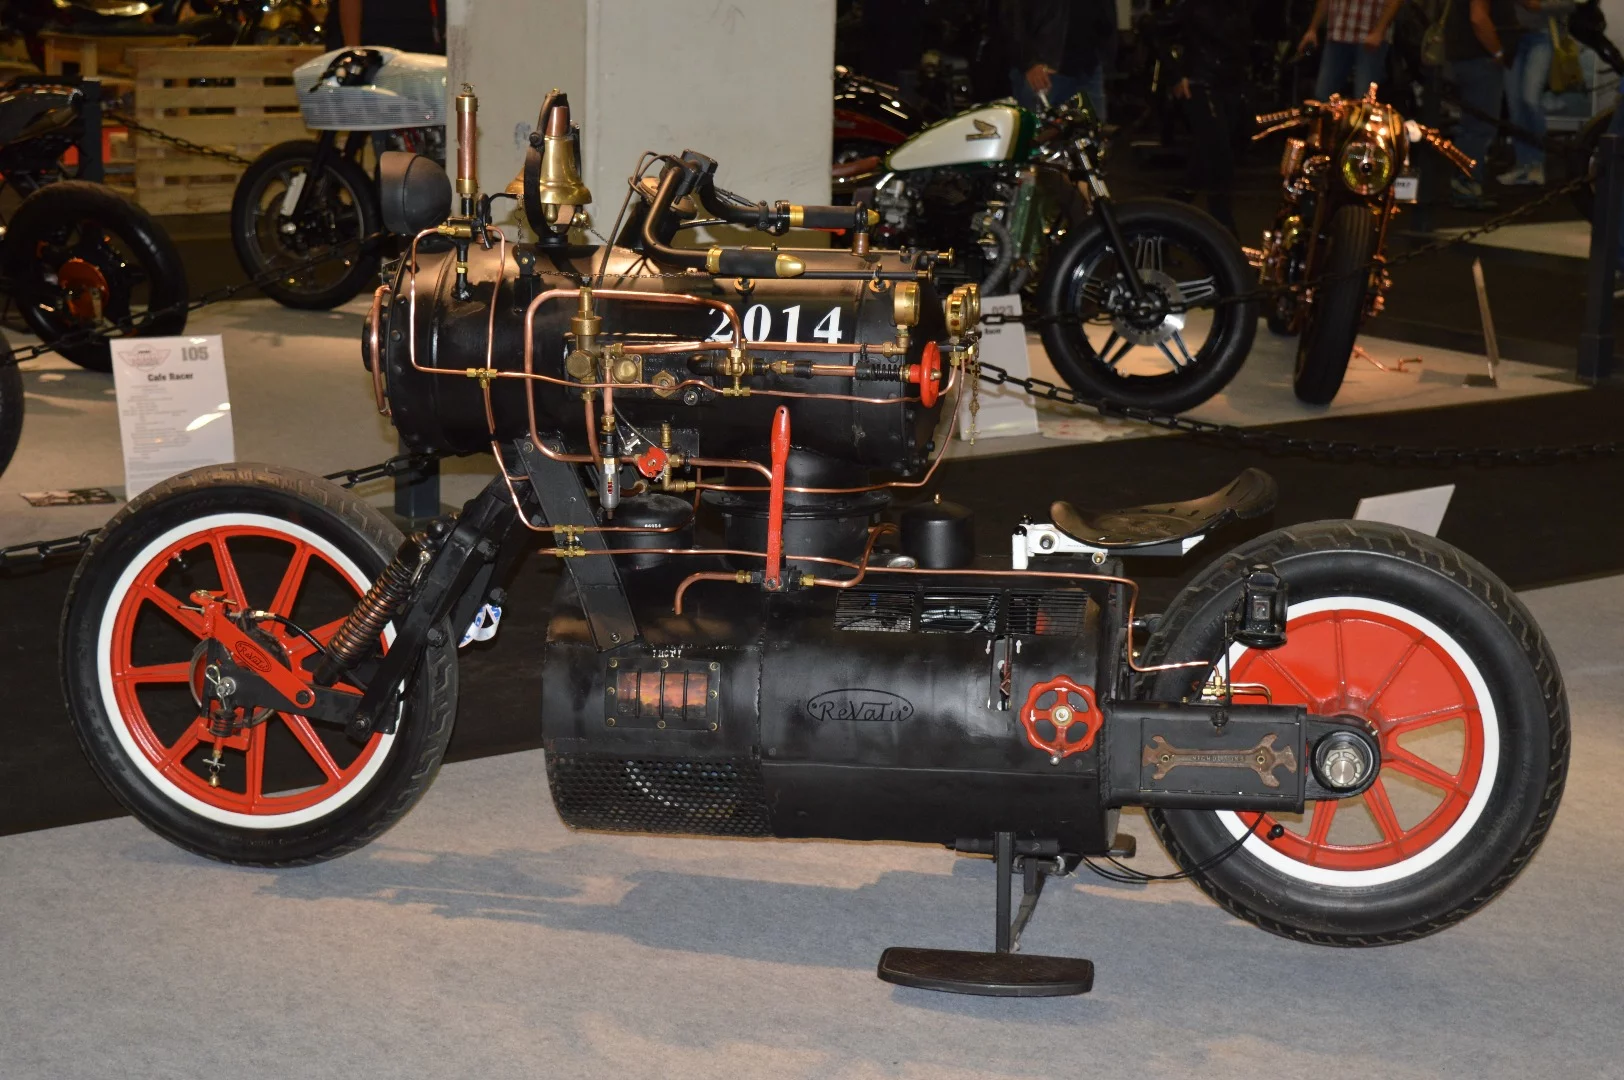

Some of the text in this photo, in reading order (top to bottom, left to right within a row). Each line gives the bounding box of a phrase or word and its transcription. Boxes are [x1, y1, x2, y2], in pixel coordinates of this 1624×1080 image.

[705, 303, 843, 344] 2014
[181, 346, 209, 361] 105
[148, 372, 193, 382] Cafe Racer
